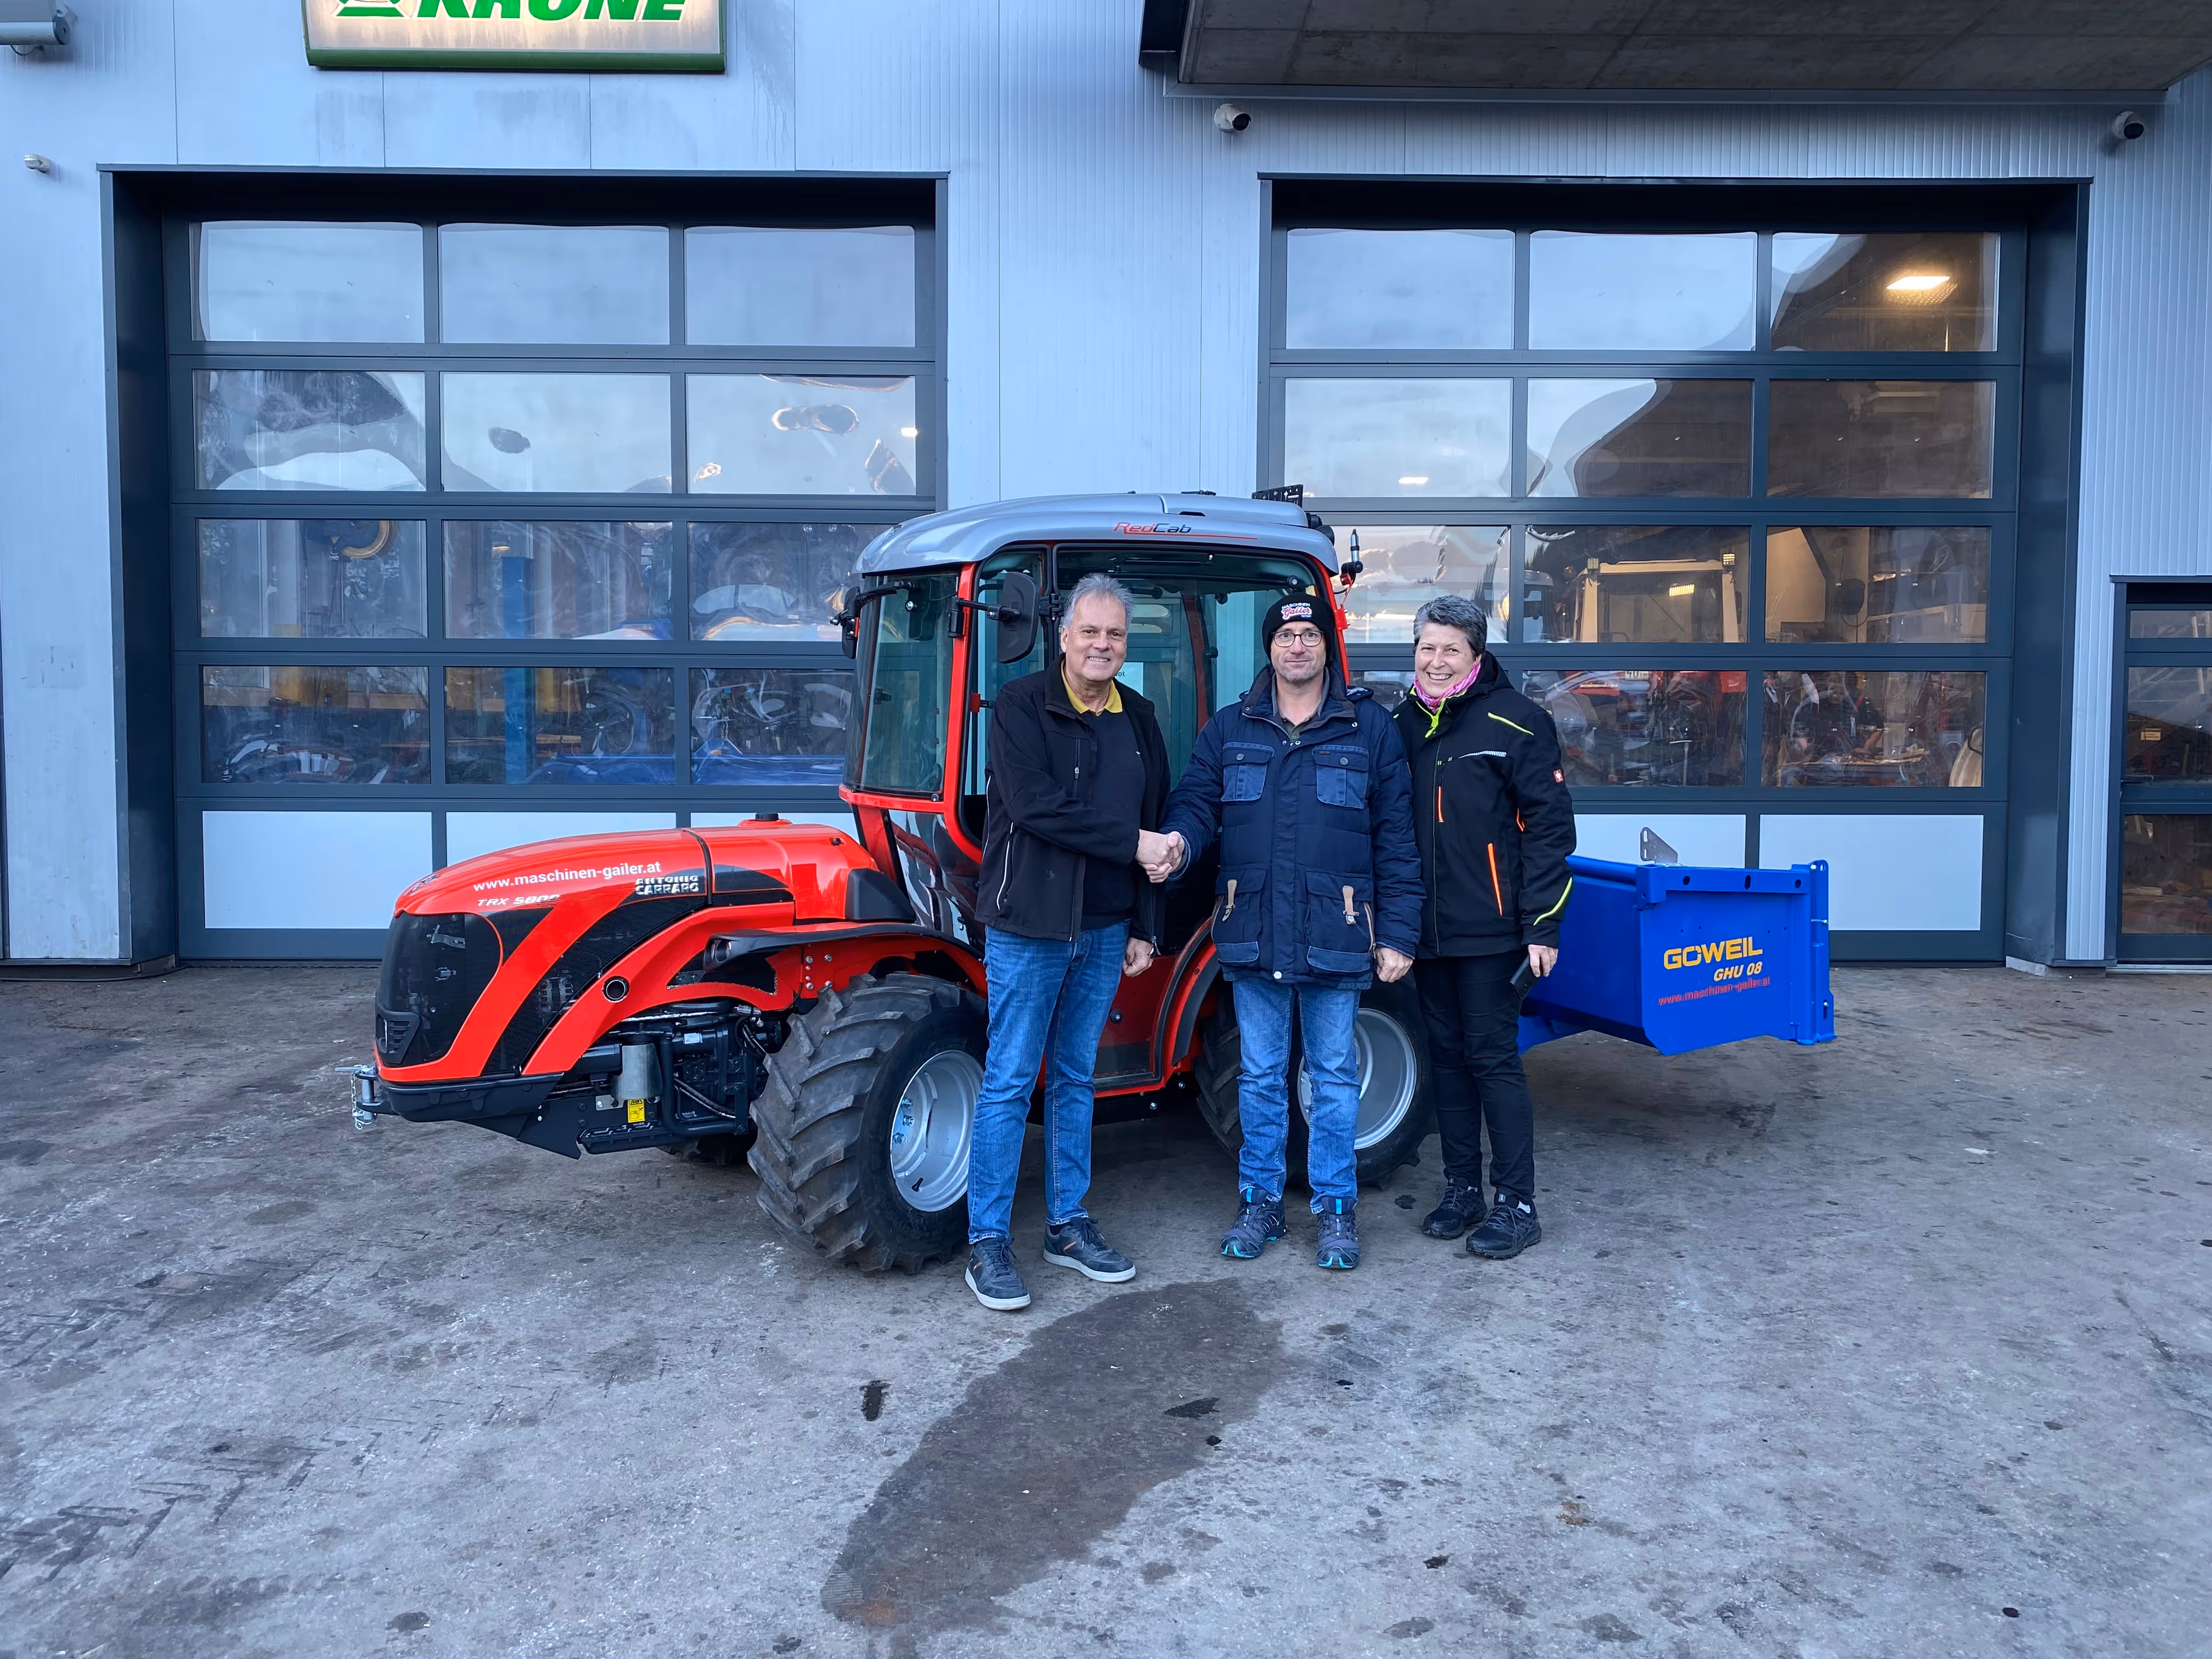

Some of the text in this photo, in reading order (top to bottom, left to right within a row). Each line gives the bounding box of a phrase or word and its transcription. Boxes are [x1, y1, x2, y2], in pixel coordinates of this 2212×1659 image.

[1113, 522, 1192, 534] RedCab
[1281, 606, 1312, 620] Gailer
[473, 861, 661, 891] www.maschinen-gailer.at
[477, 898, 509, 906] TRX
[1713, 961, 1763, 981] GHU 08
[1658, 976, 1771, 1006] www.maschinen-gailer.at
